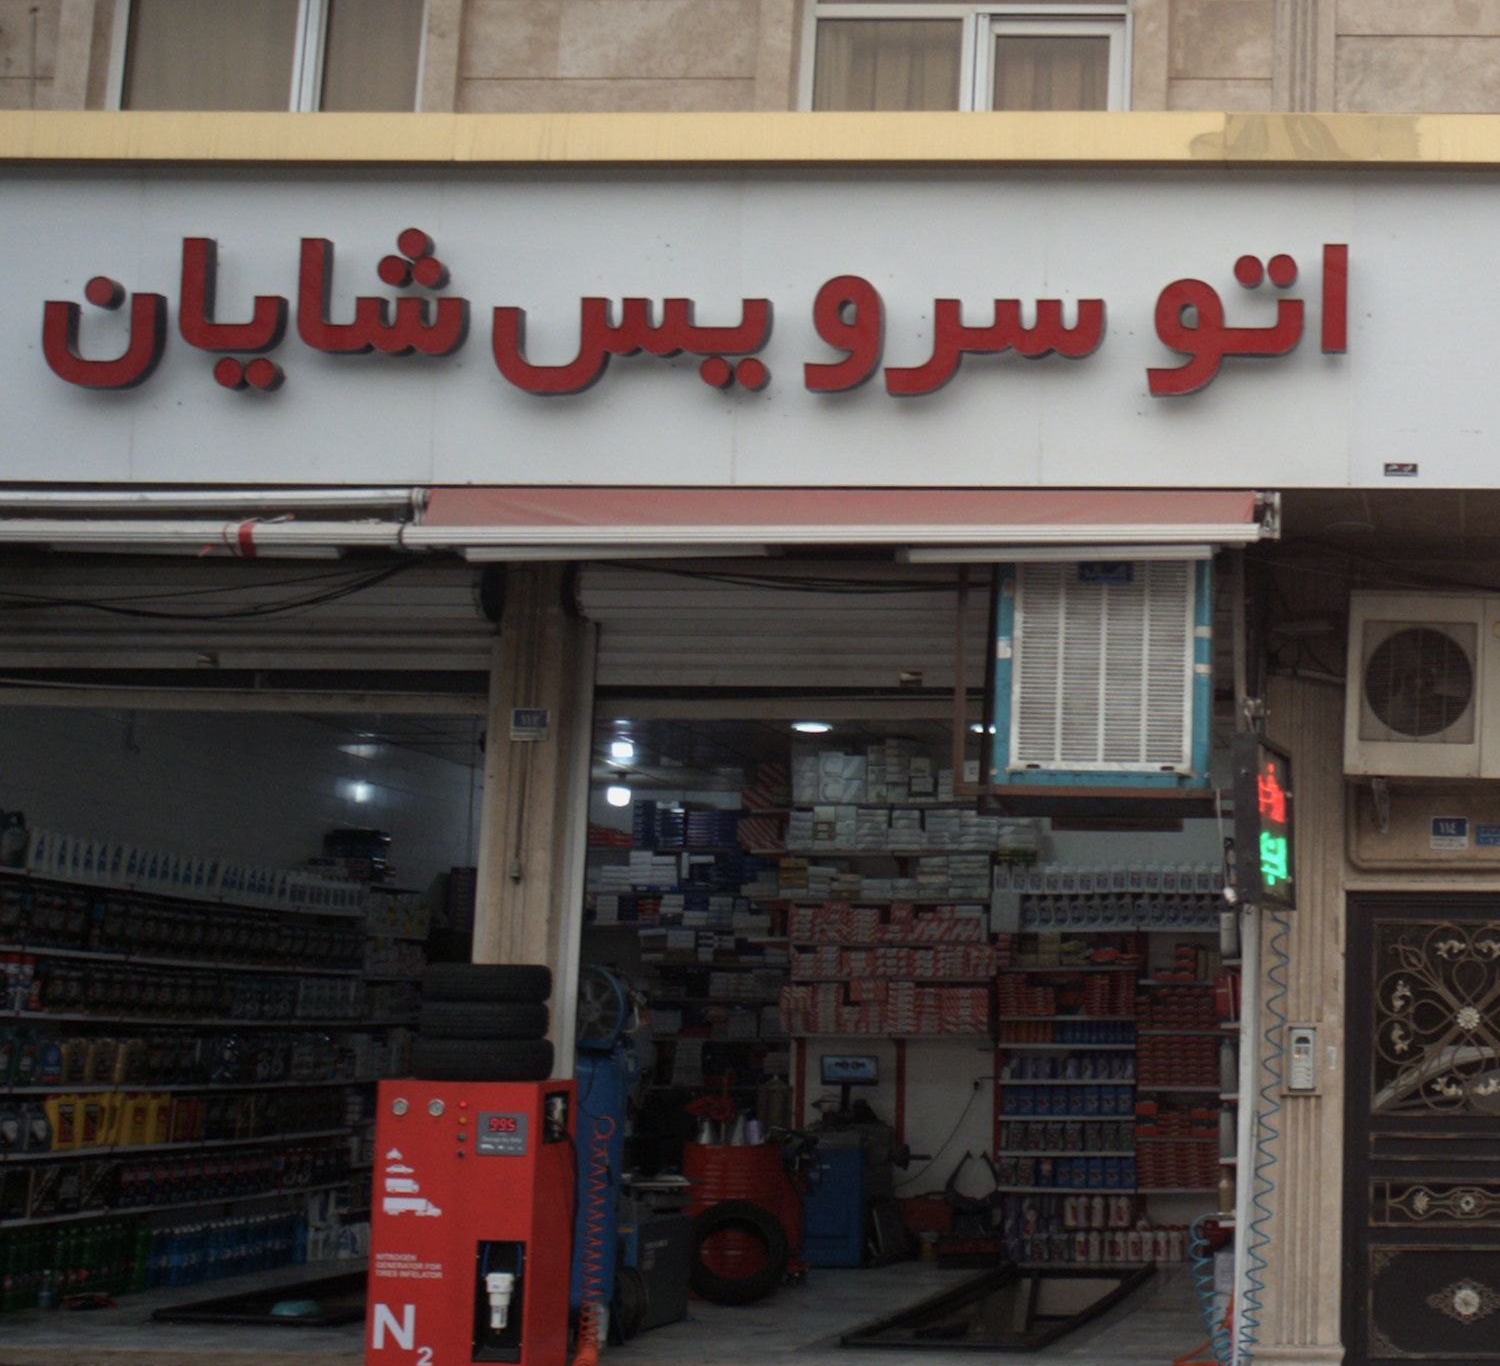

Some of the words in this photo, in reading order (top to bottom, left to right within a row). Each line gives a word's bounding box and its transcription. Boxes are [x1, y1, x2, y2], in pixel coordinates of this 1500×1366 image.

[41, 227, 471, 391] شایان
[376, 1252, 417, 1261] NITROGEN
[425, 1263, 442, 1271] FOR
